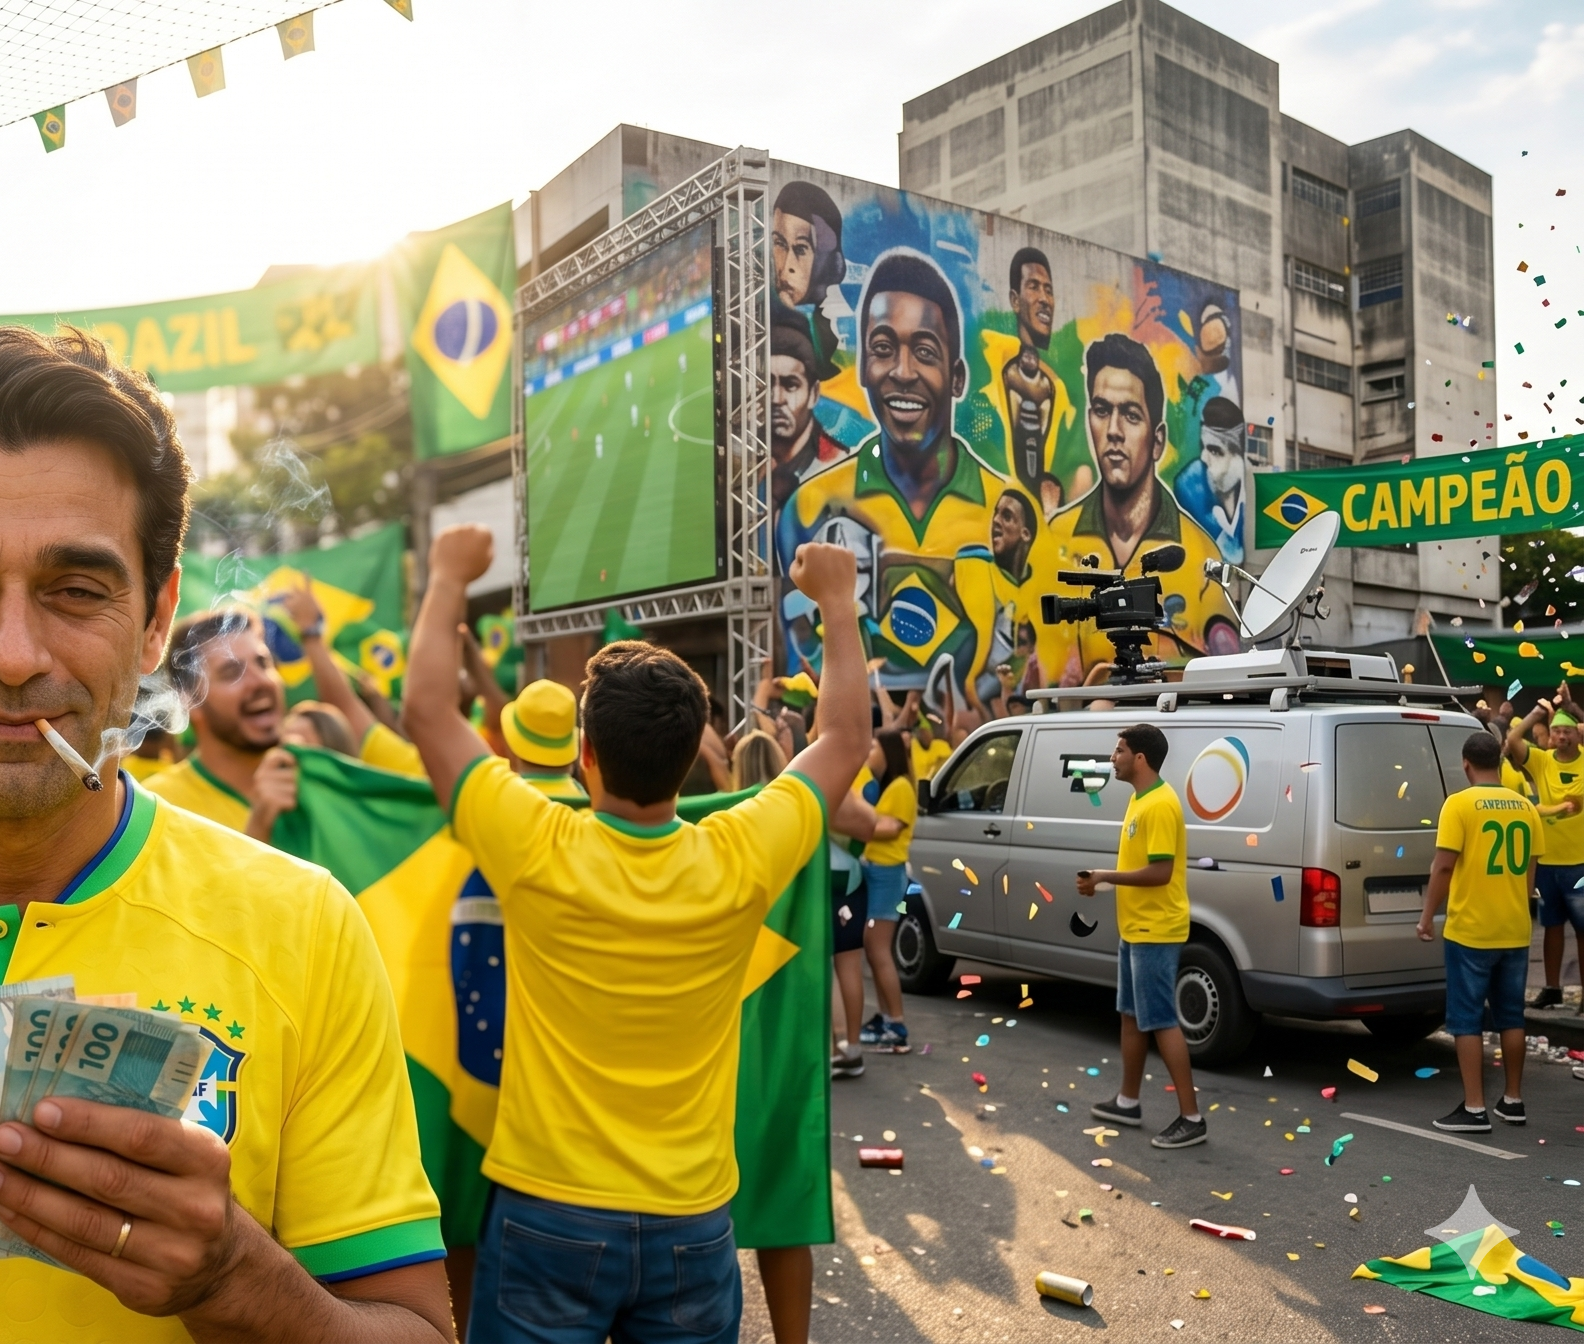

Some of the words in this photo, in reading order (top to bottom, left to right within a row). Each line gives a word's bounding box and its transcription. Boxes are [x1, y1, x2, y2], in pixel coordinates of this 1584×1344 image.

[1342, 451, 1572, 532] CAMPEÃO
[1482, 820, 1531, 876] 20
[78, 1021, 119, 1071] 100
